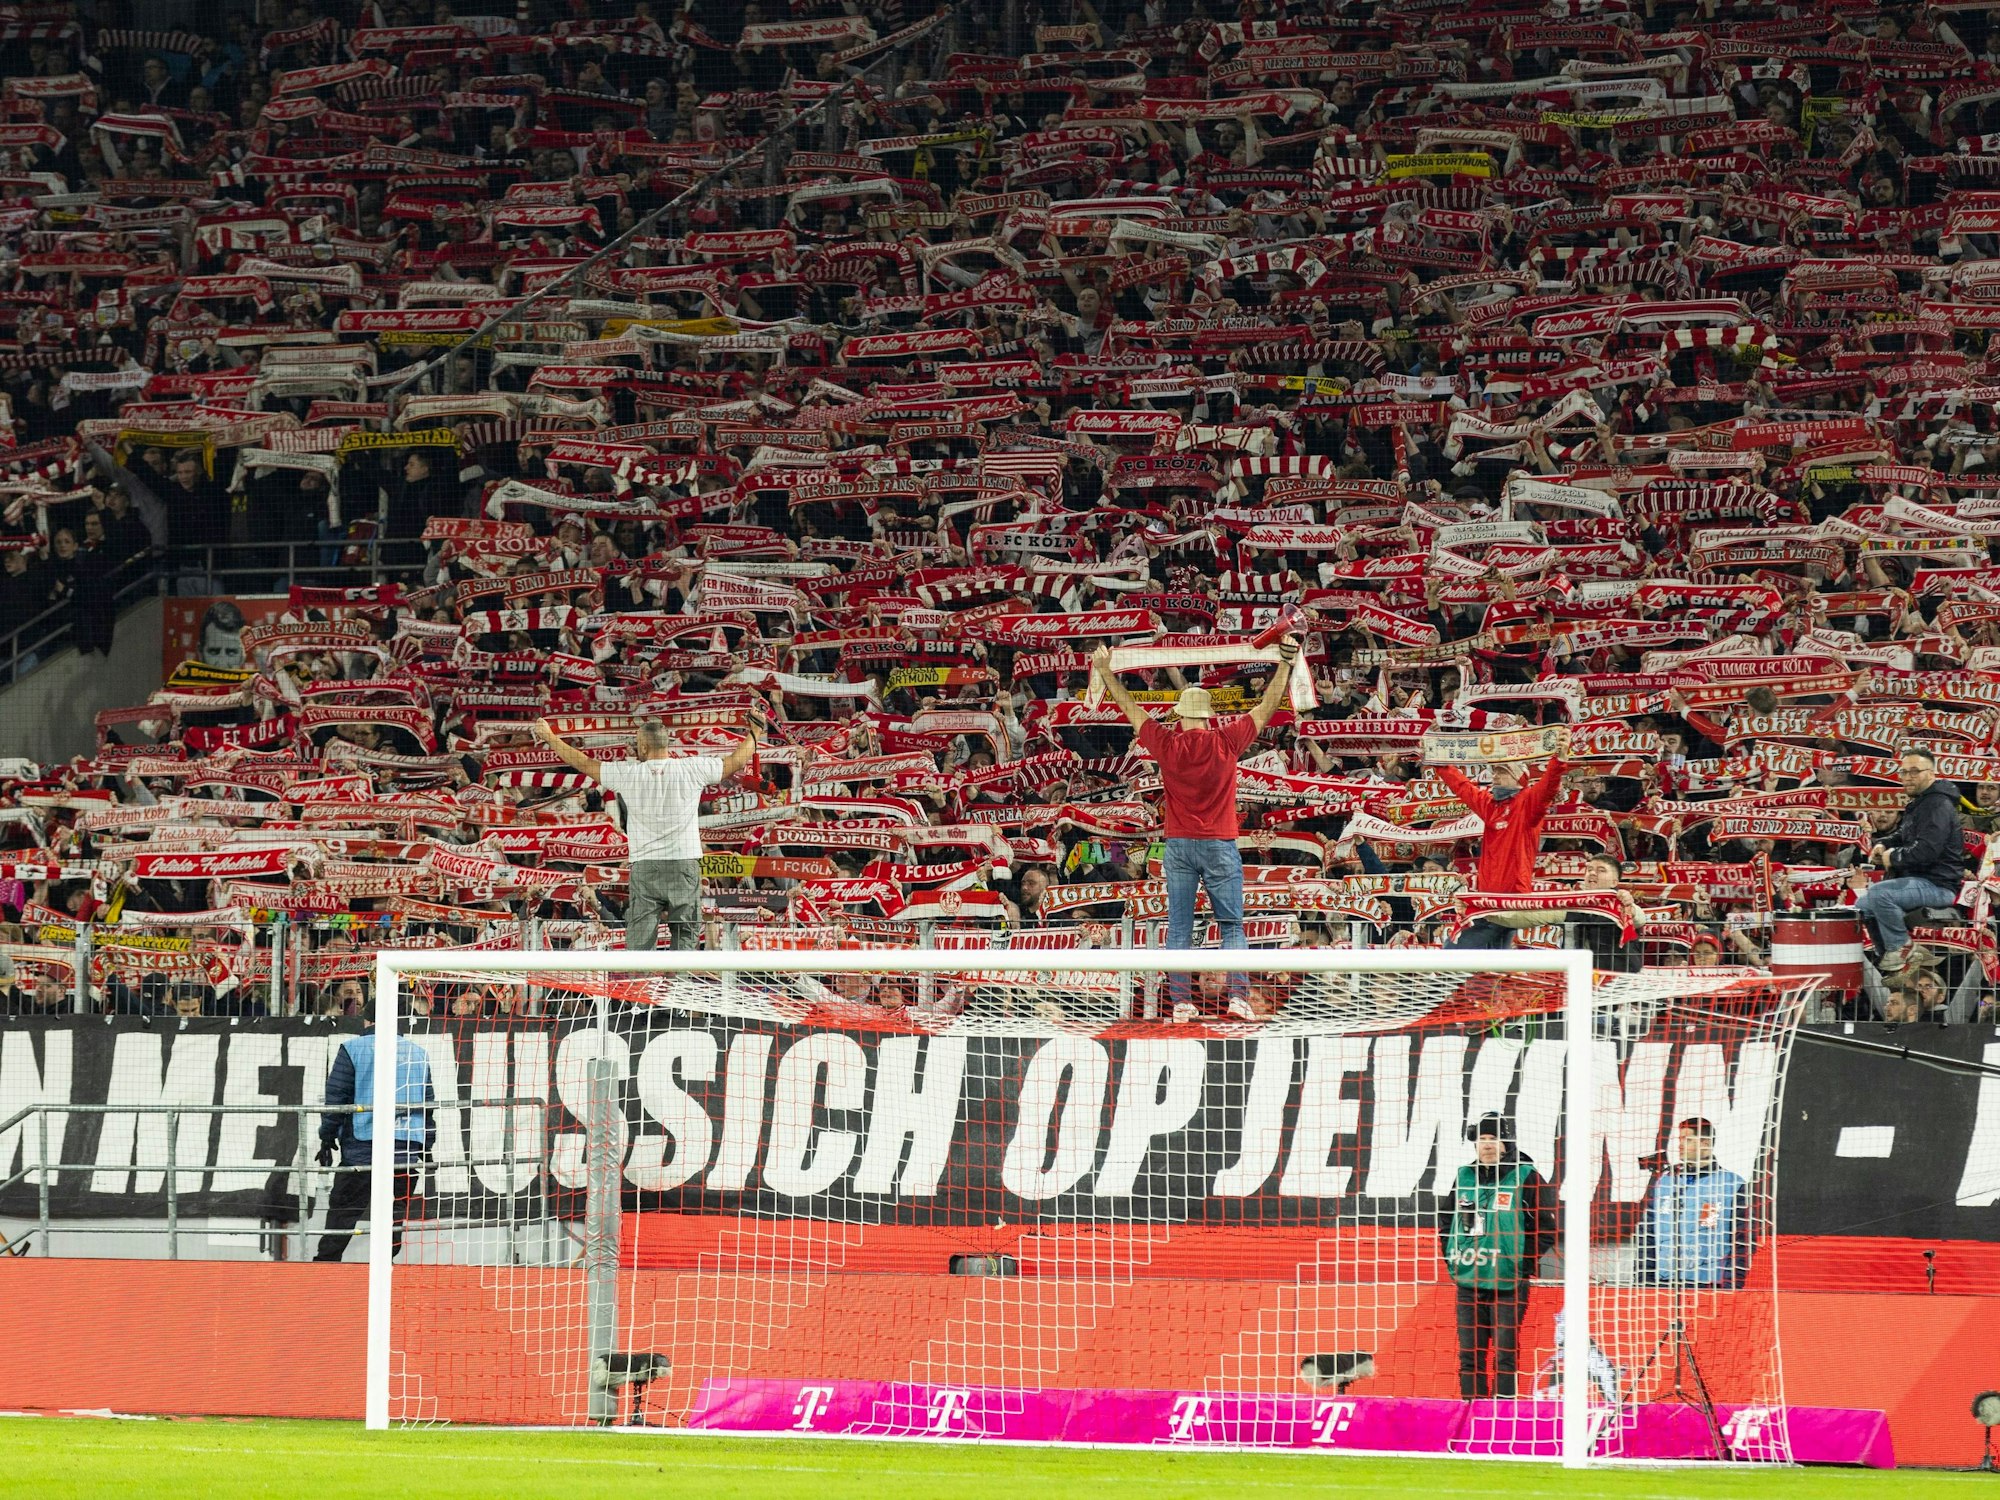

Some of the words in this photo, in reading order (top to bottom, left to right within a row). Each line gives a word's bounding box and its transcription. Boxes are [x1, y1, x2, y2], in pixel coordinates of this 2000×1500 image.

[818, 484, 852, 498] SIND
[857, 482, 881, 495] DIE
[808, 569, 895, 591] DOMSTADT
[345, 590, 378, 600] FC
[924, 641, 955, 653] BIN
[506, 660, 535, 673] BIN
[1307, 719, 1422, 735] SÜDTRIBÜNE
[247, 726, 285, 744] KÖLN
[777, 829, 891, 848] DOUBLESIEGER
[698, 855, 741, 866] RUSSIA
[783, 860, 805, 872] FC
[698, 864, 745, 876] TMUND
[1003, 1038, 1206, 1201] OP
